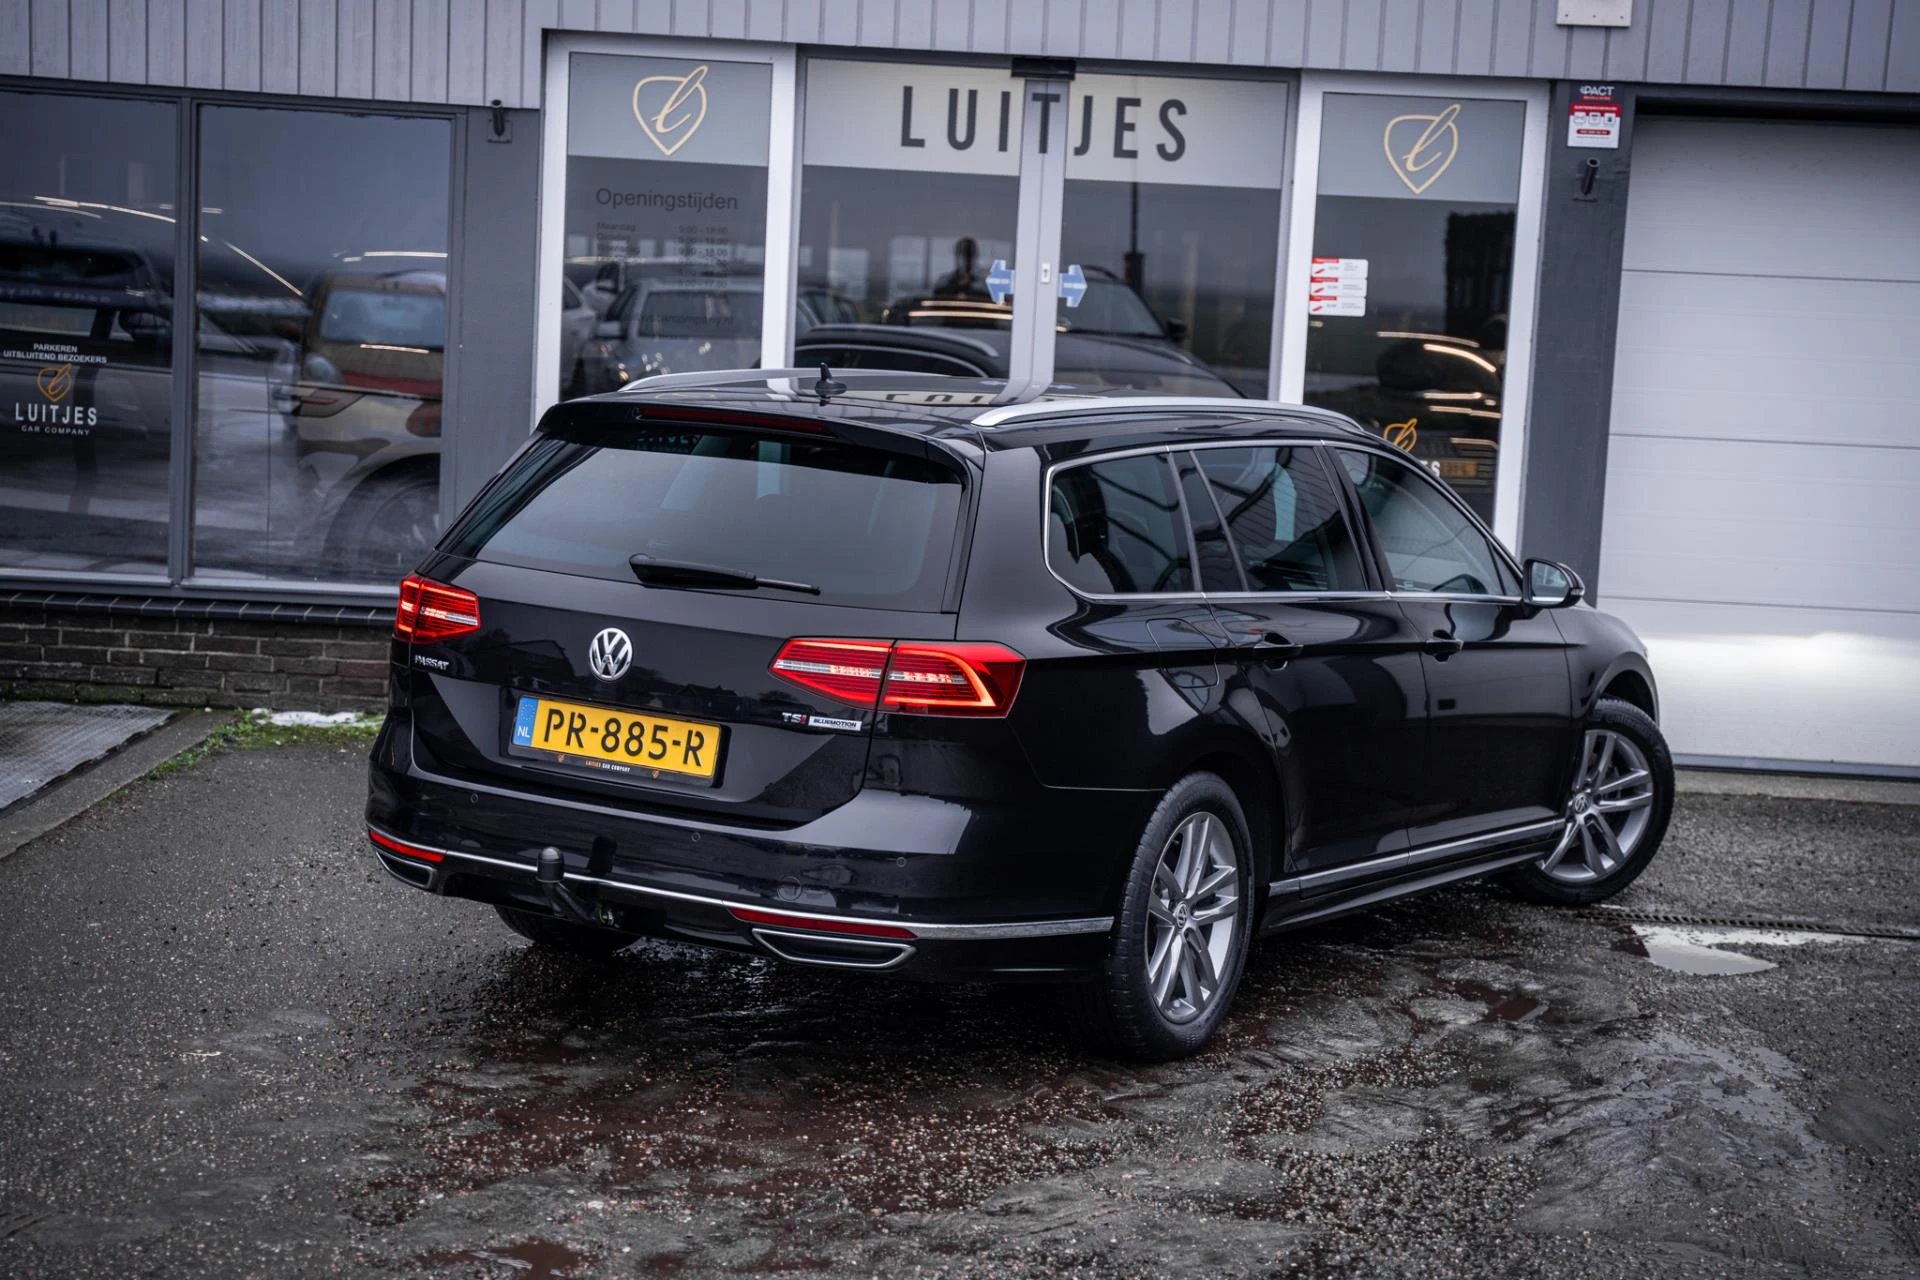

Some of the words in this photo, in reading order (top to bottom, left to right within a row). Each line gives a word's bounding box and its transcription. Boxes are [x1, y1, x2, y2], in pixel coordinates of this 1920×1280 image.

[900, 85, 1188, 162] LUITJES
[596, 188, 738, 213] Openingstijden
[33, 343, 78, 353] PARKEREN
[3, 350, 56, 361] UITSLUITEND
[57, 353, 107, 364] BEZOEKERS
[15, 402, 97, 426] LUITJES
[44, 426, 90, 436] COMPANY
[414, 654, 449, 670] PASSAT
[517, 725, 531, 738] NL
[543, 708, 705, 767] PR-885-R
